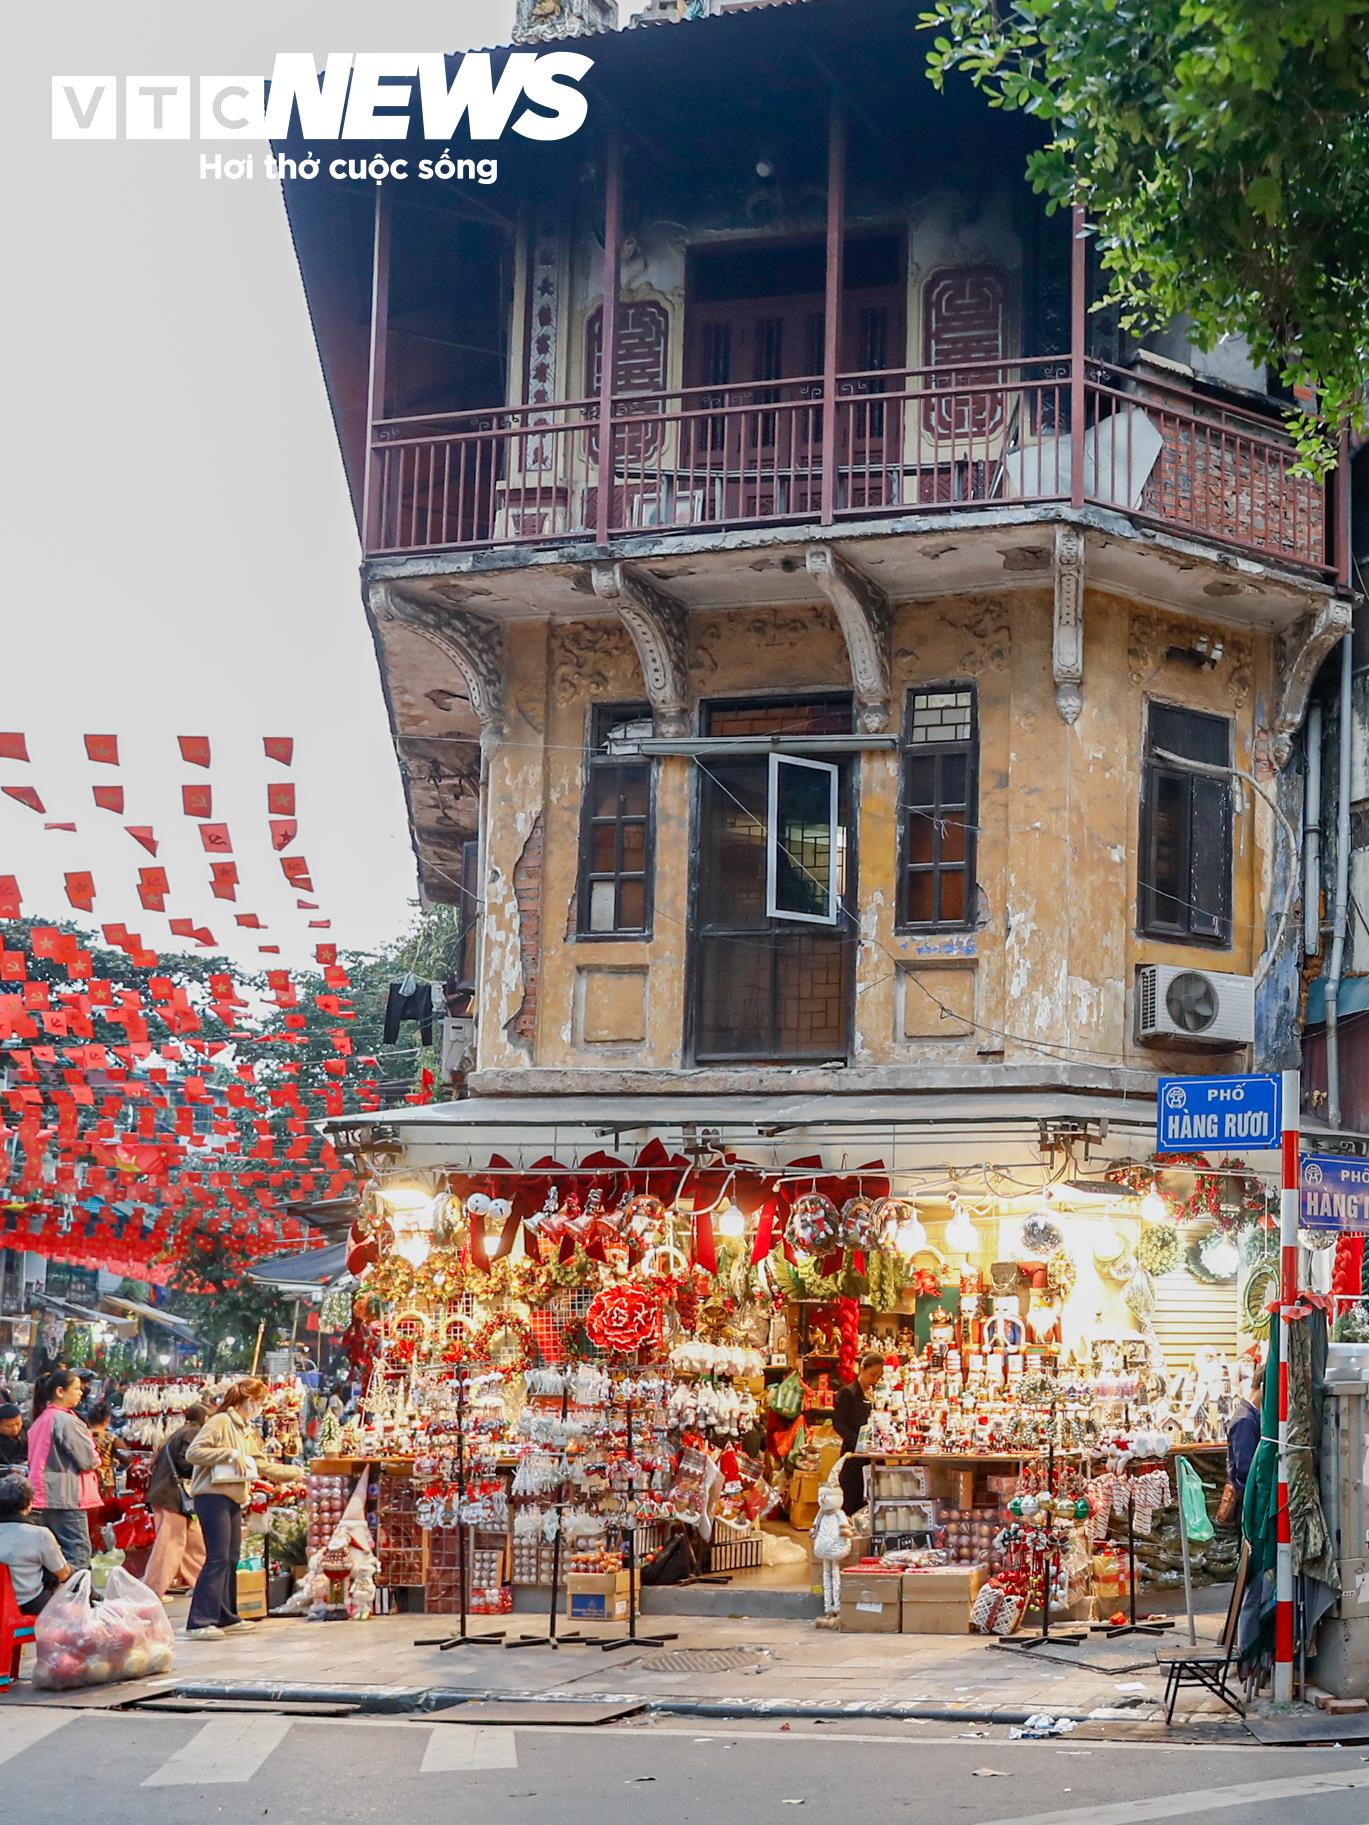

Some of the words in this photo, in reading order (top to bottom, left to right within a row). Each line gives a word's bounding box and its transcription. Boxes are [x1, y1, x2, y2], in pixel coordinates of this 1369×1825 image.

[1207, 1083, 1247, 1102] PHỐ
[1167, 1108, 1219, 1139] HÀNG
[1224, 1110, 1269, 1138] RƯƠI
[1306, 1187, 1360, 1218] HÀNG
